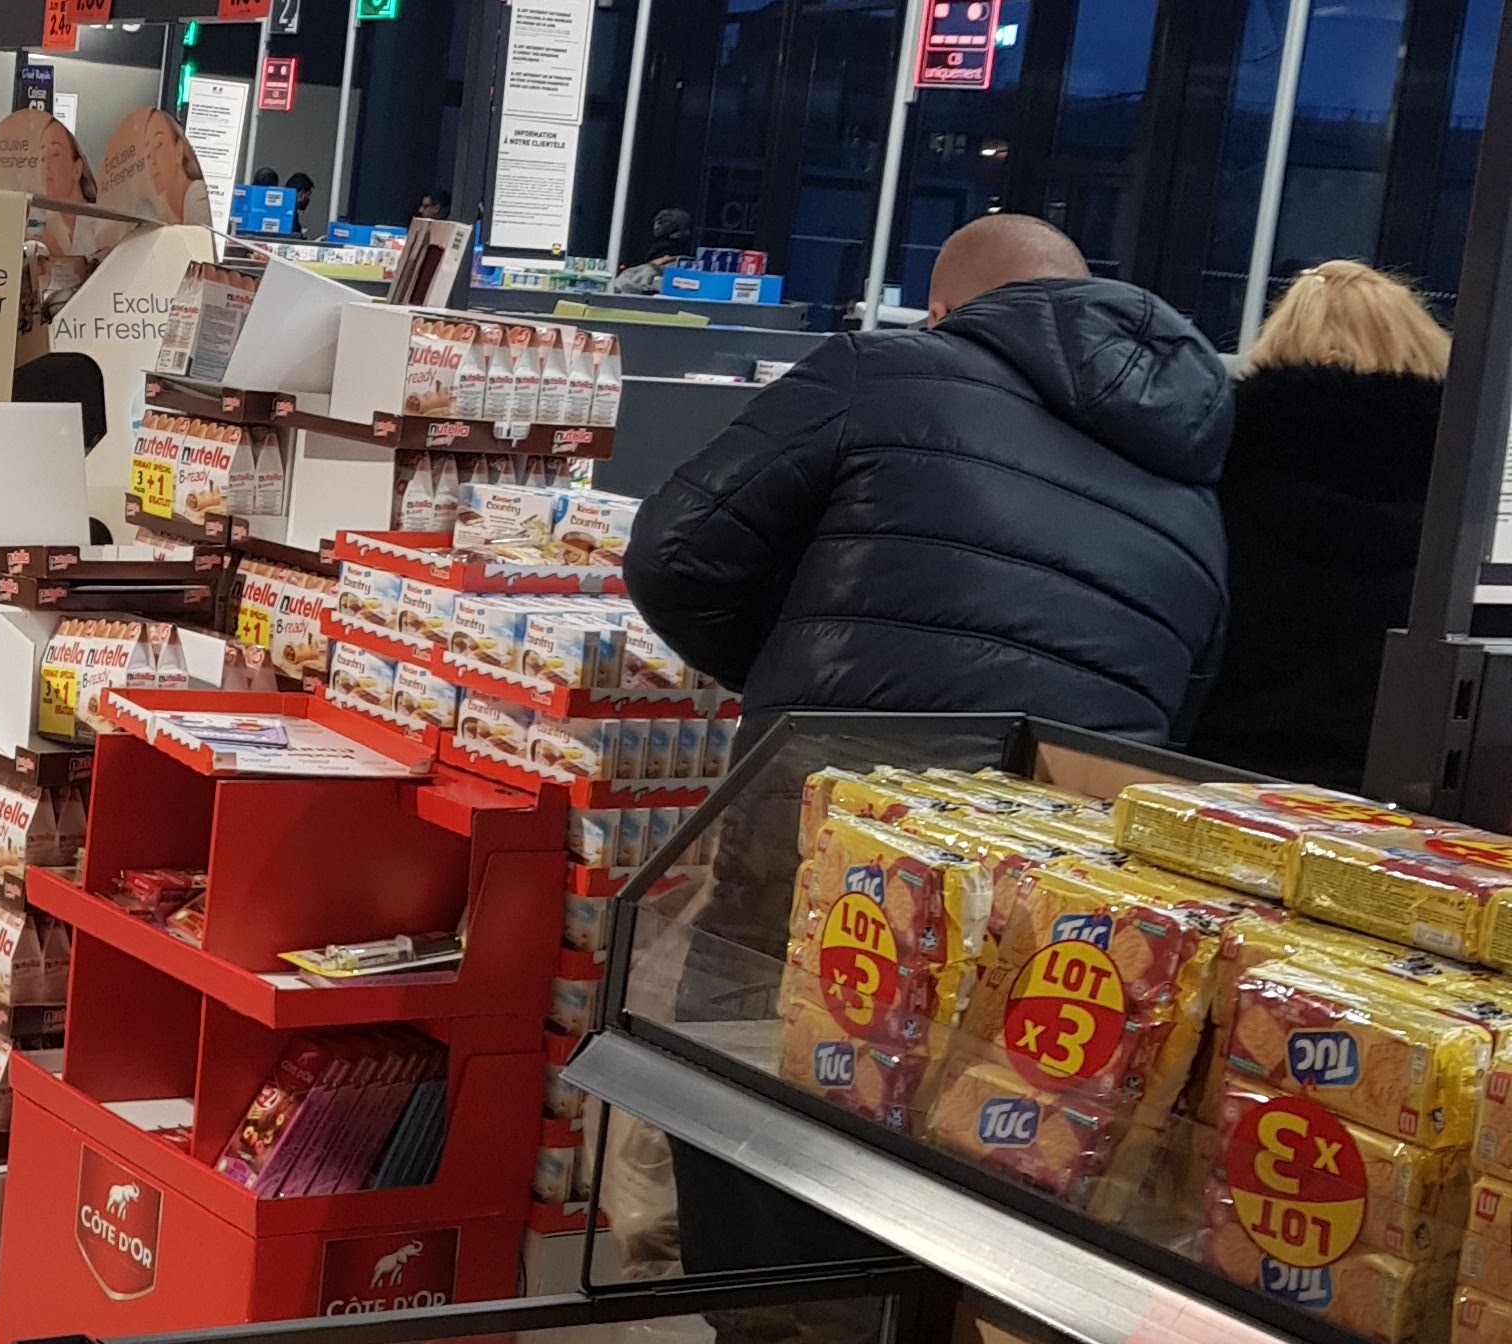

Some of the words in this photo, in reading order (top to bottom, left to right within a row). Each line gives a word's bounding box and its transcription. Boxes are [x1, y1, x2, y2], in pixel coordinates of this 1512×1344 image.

[923, 65, 983, 82] uniquement
[514, 129, 558, 139] INFORMATION
[113, 292, 175, 314] Exclu
[54, 318, 88, 340] Air
[94, 318, 168, 340] Freshe
[180, 445, 230, 471] nutella
[135, 470, 143, 486] 3
[178, 468, 211, 488] B-ready
[486, 501, 521, 517] Country
[570, 514, 610, 533] Country
[276, 617, 310, 639] B-ready
[44, 679, 52, 697] 3
[841, 901, 886, 951] LOT
[1042, 949, 1113, 1002] LOT
[832, 954, 881, 1027] x3
[1017, 1002, 1096, 1079] x3
[815, 1047, 855, 1086] TUC
[1294, 1036, 1357, 1083] TUC
[980, 1099, 1041, 1146] TUC
[1254, 1110, 1344, 1196] x3
[80, 1203, 117, 1248] CÔTE
[118, 1234, 153, 1271] D'OR
[1250, 1199, 1332, 1258] LOT
